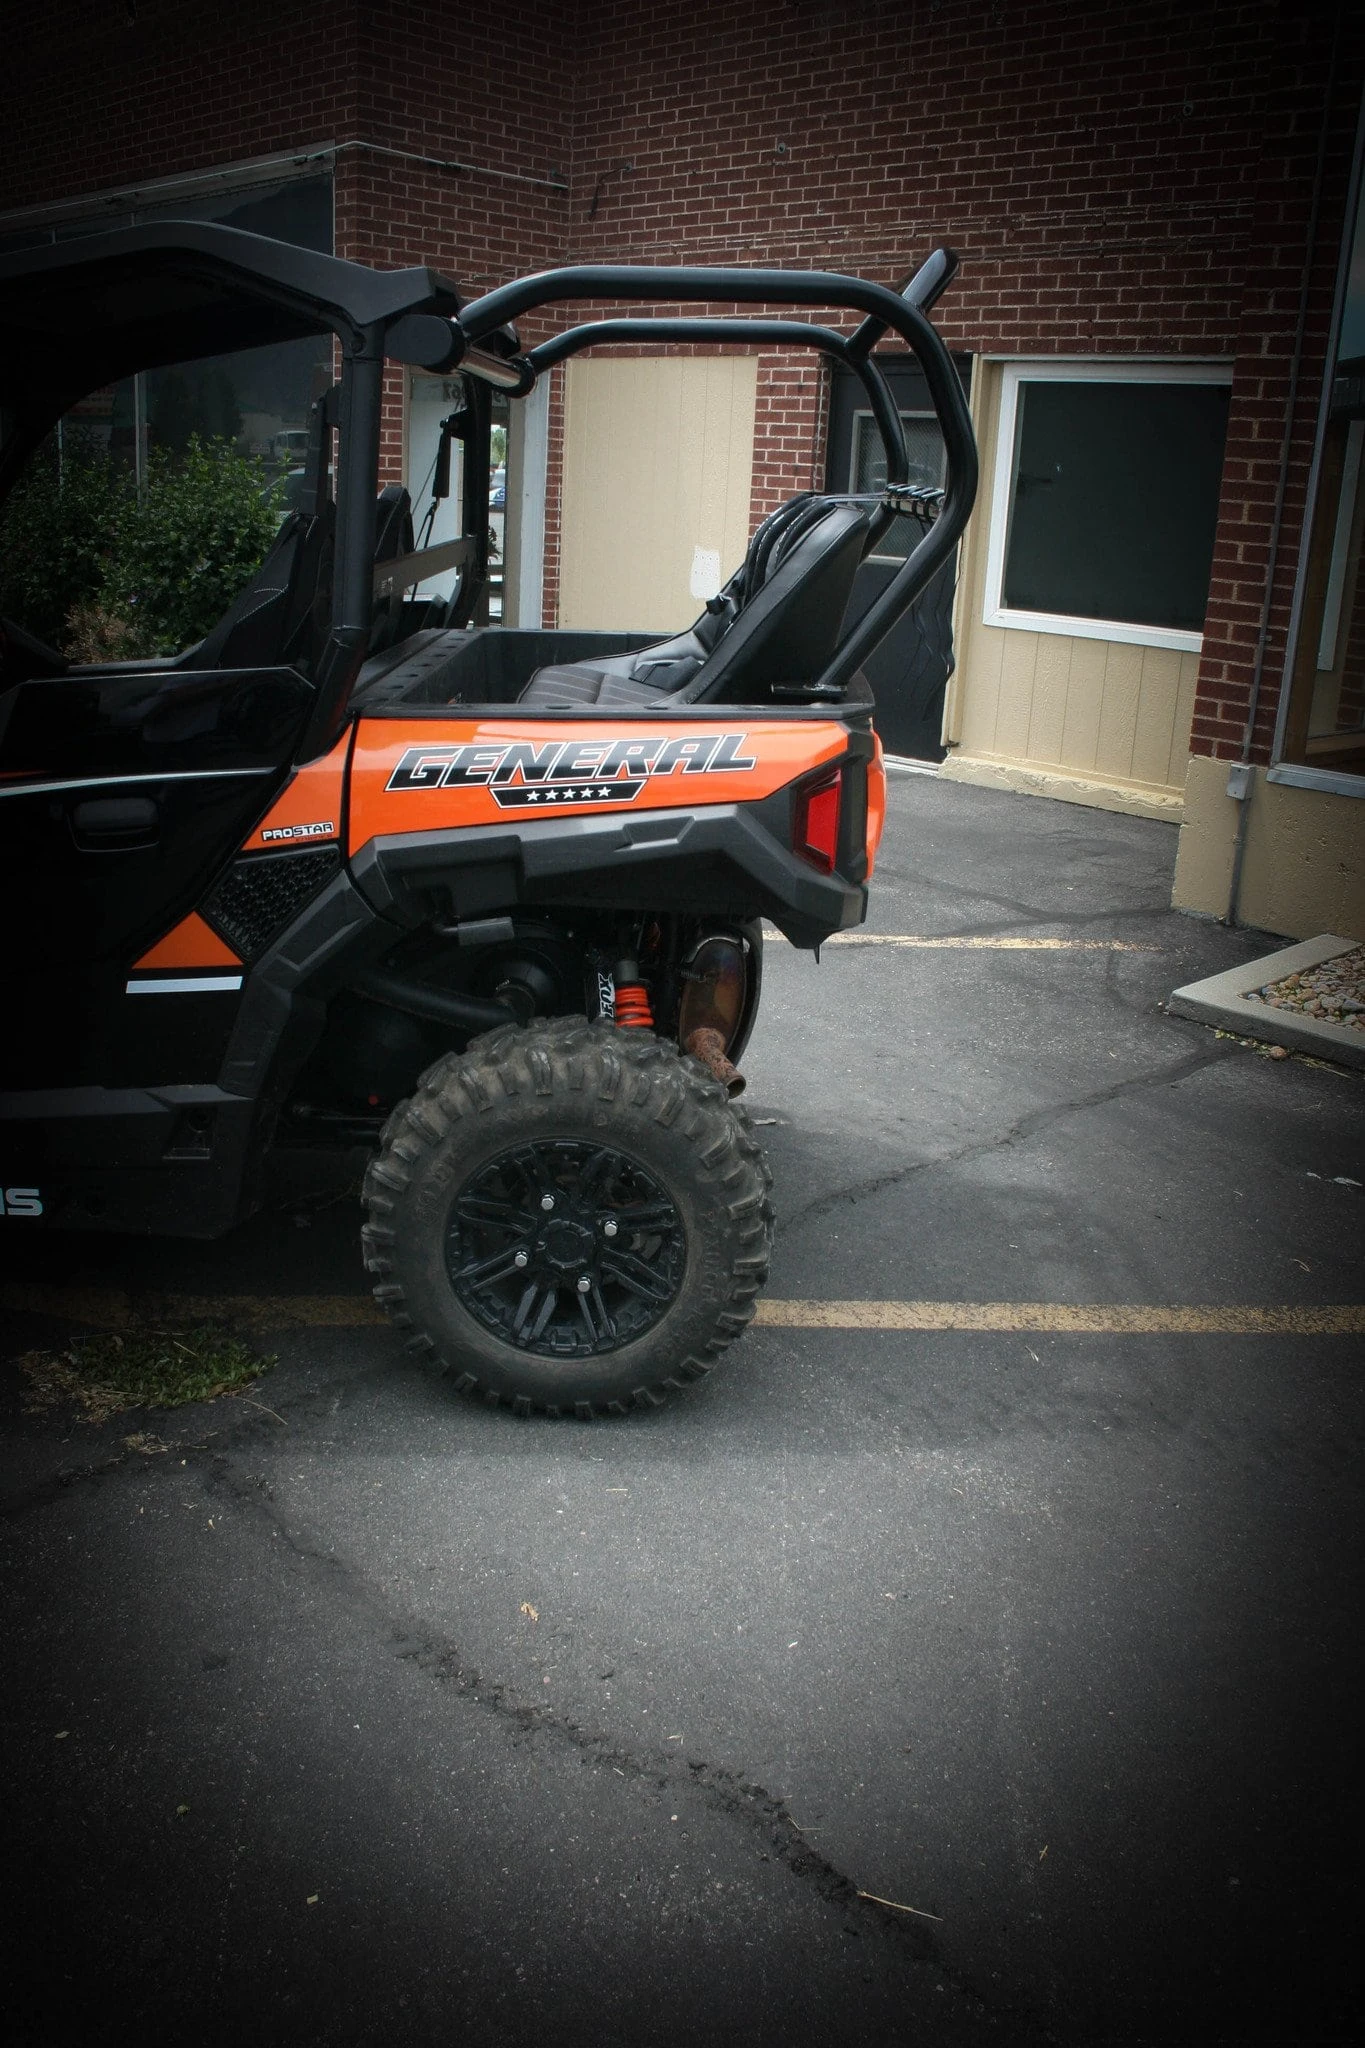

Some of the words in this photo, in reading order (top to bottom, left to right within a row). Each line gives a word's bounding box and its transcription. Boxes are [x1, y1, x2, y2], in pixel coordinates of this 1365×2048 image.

[385, 734, 757, 792] GENERAL
[262, 822, 335, 841] PROSTAR
[598, 972, 616, 1018] FOX
